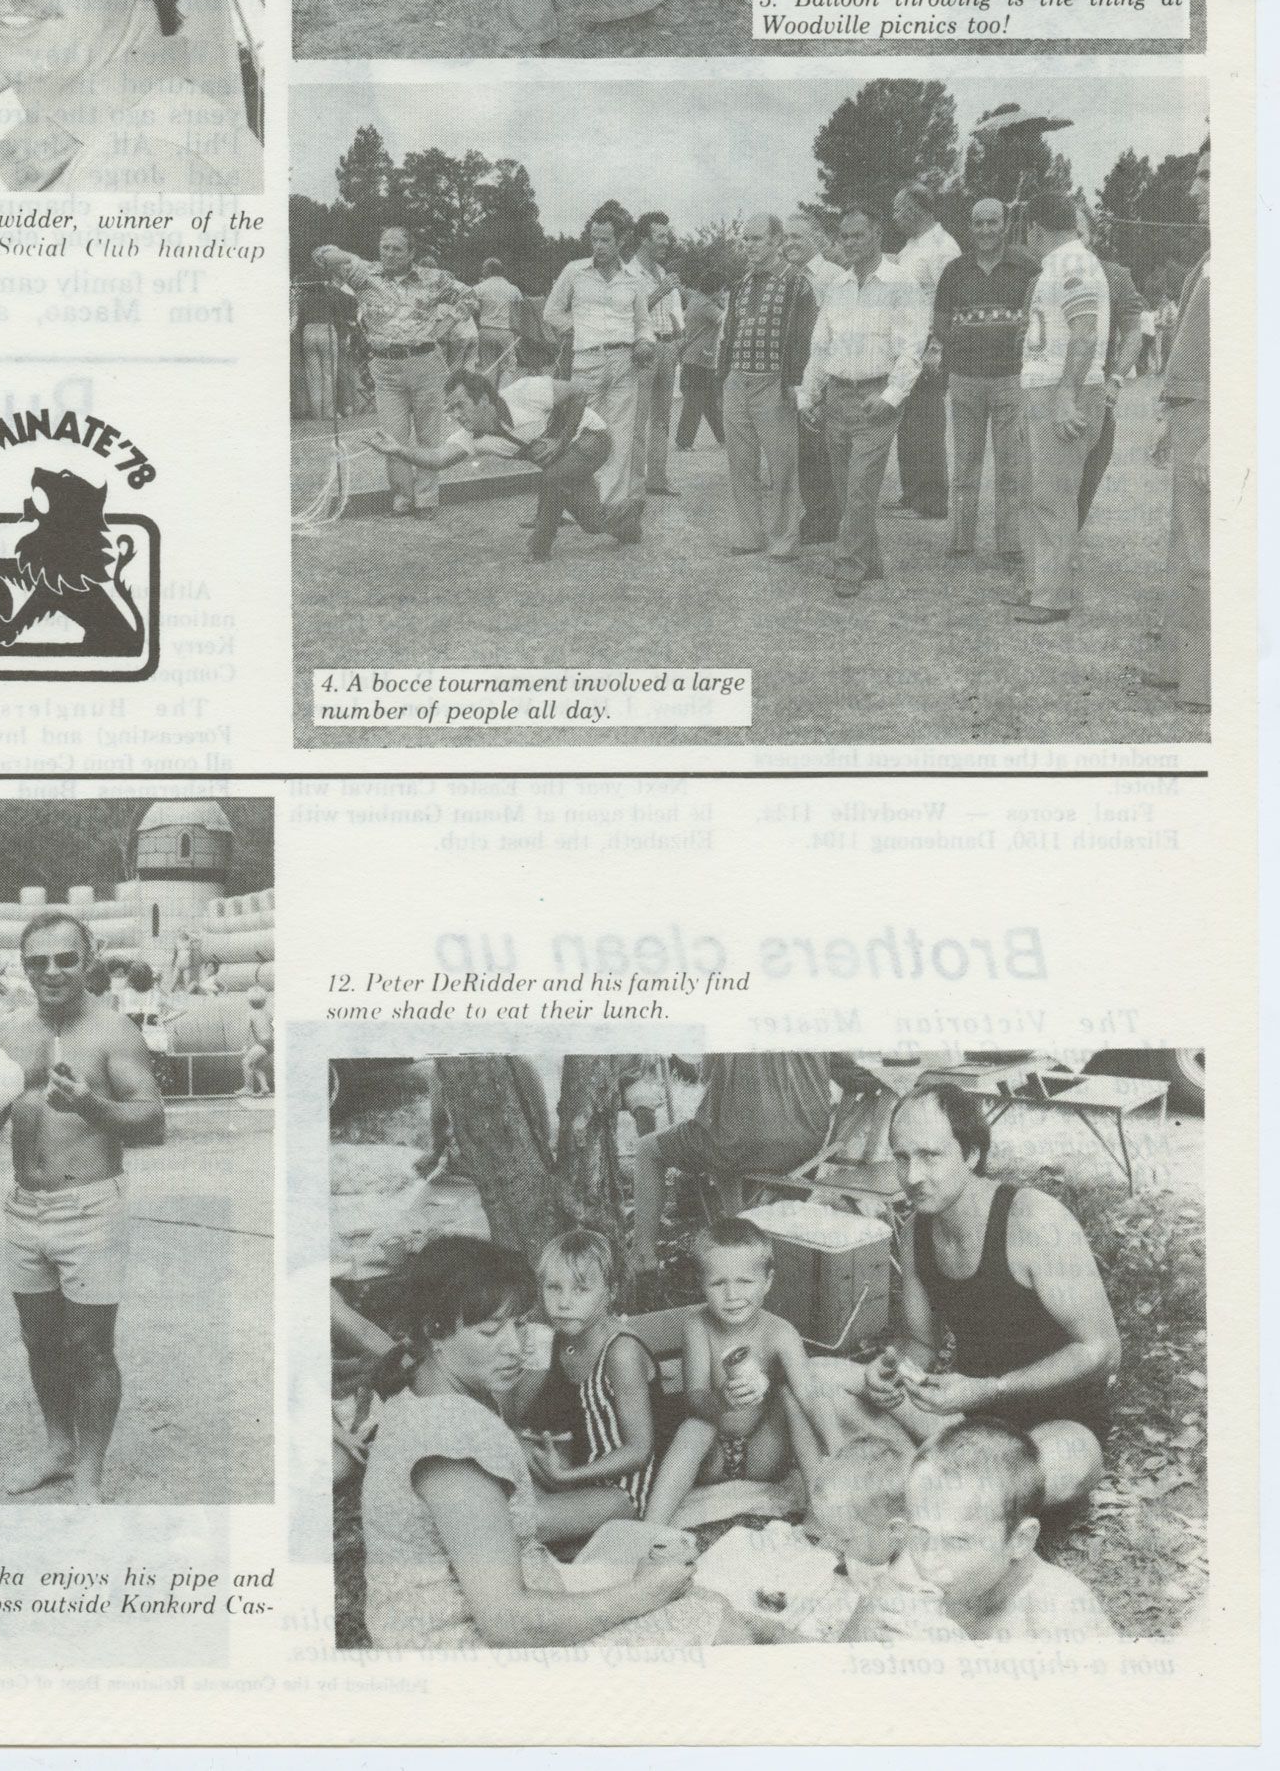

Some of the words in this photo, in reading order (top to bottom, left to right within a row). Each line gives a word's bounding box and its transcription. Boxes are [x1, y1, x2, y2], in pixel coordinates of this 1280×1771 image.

[762, 14, 871, 35] Woodville
[879, 14, 957, 39] picnics
[967, 13, 1011, 34] too!
[98, 209, 174, 230] winner
[191, 210, 213, 234] of
[229, 210, 264, 230] the
[321, 674, 338, 693] 4.
[346, 673, 362, 692] A
[372, 672, 433, 693] bocce
[439, 675, 568, 693] tournament
[574, 672, 668, 692] involved
[672, 678, 685, 692] a
[692, 671, 745, 695] large
[321, 699, 408, 720] number
[417, 700, 439, 724] of
[446, 700, 519, 725] people
[528, 699, 556, 720] all
[566, 699, 611, 724] day.
[329, 974, 356, 992] 12.
[366, 972, 426, 993] Peter
[432, 972, 538, 993] DeRidder
[542, 972, 585, 993] and
[591, 972, 623, 993] his
[627, 971, 697, 997] family
[705, 971, 751, 996] find
[40, 1566, 108, 1590] enjoys
[124, 1566, 156, 1587] his
[169, 1566, 219, 1592] pipe
[233, 1567, 275, 1588] and
